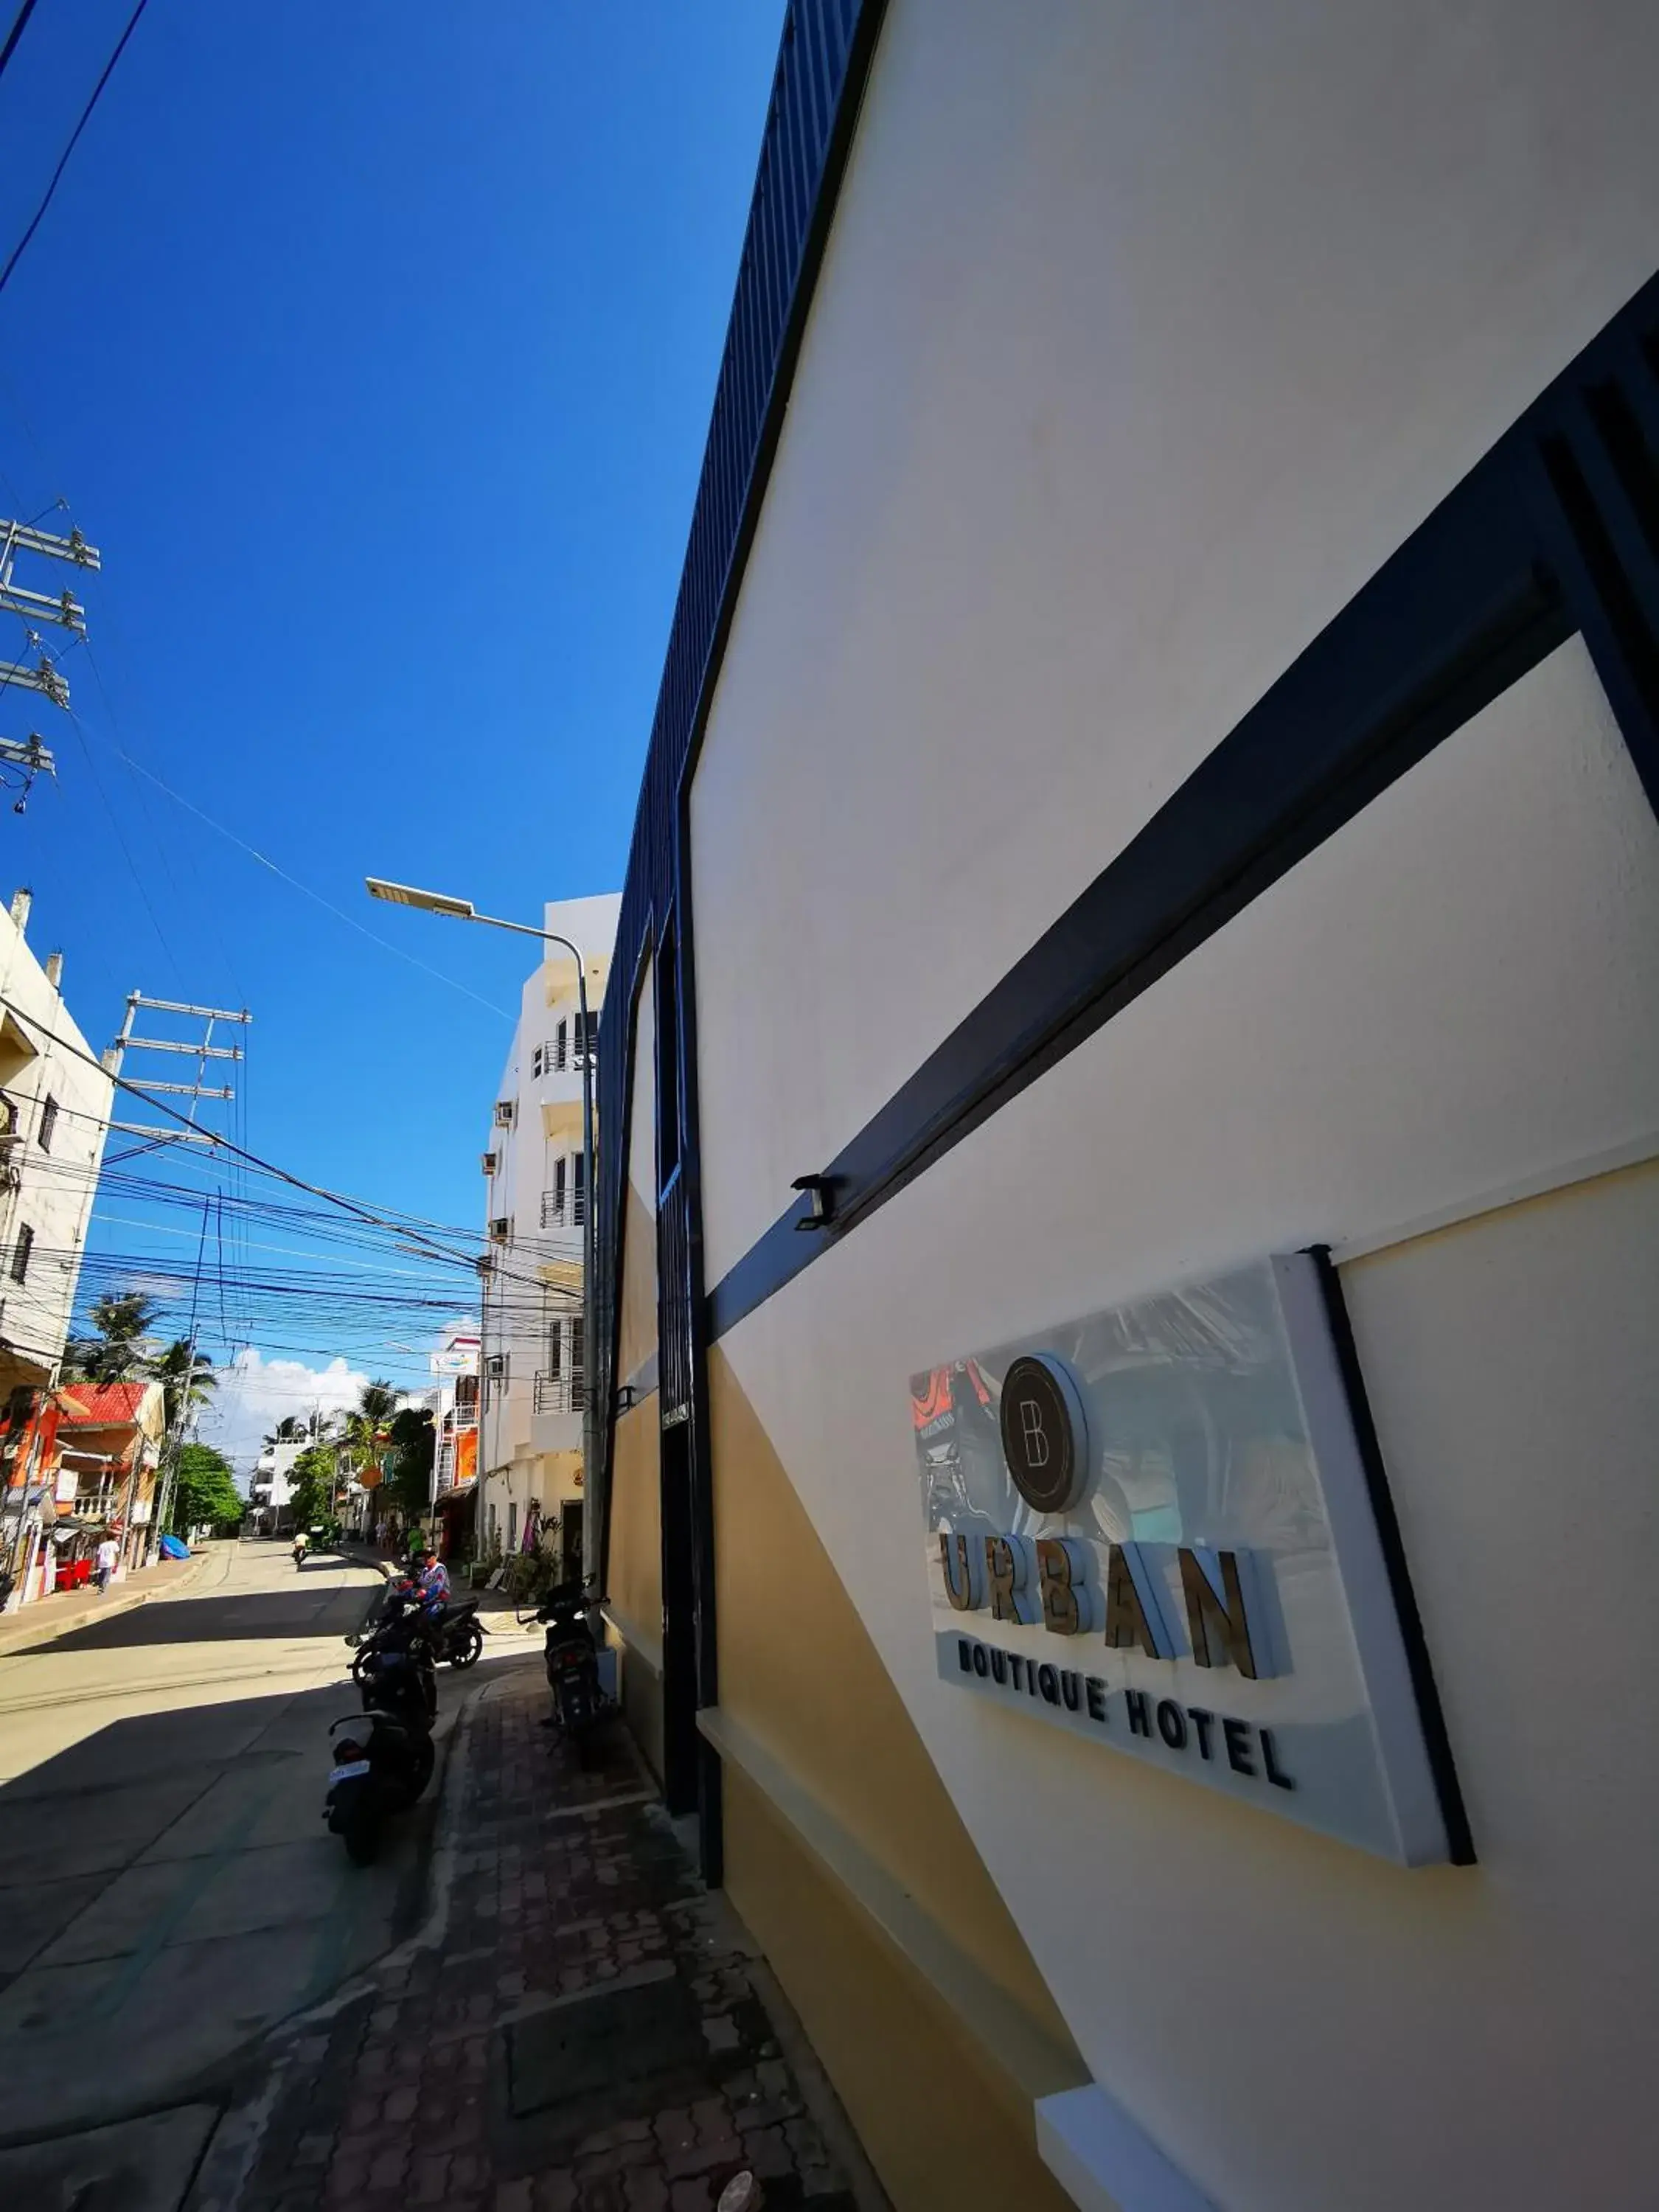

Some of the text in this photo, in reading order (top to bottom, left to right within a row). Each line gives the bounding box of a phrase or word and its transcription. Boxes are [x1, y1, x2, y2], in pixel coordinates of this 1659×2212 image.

[1020, 1400, 1048, 1466] B
[939, 1533, 1271, 1680] URBAN
[959, 1638, 1295, 1790] BOUTIQUE HOTEL
